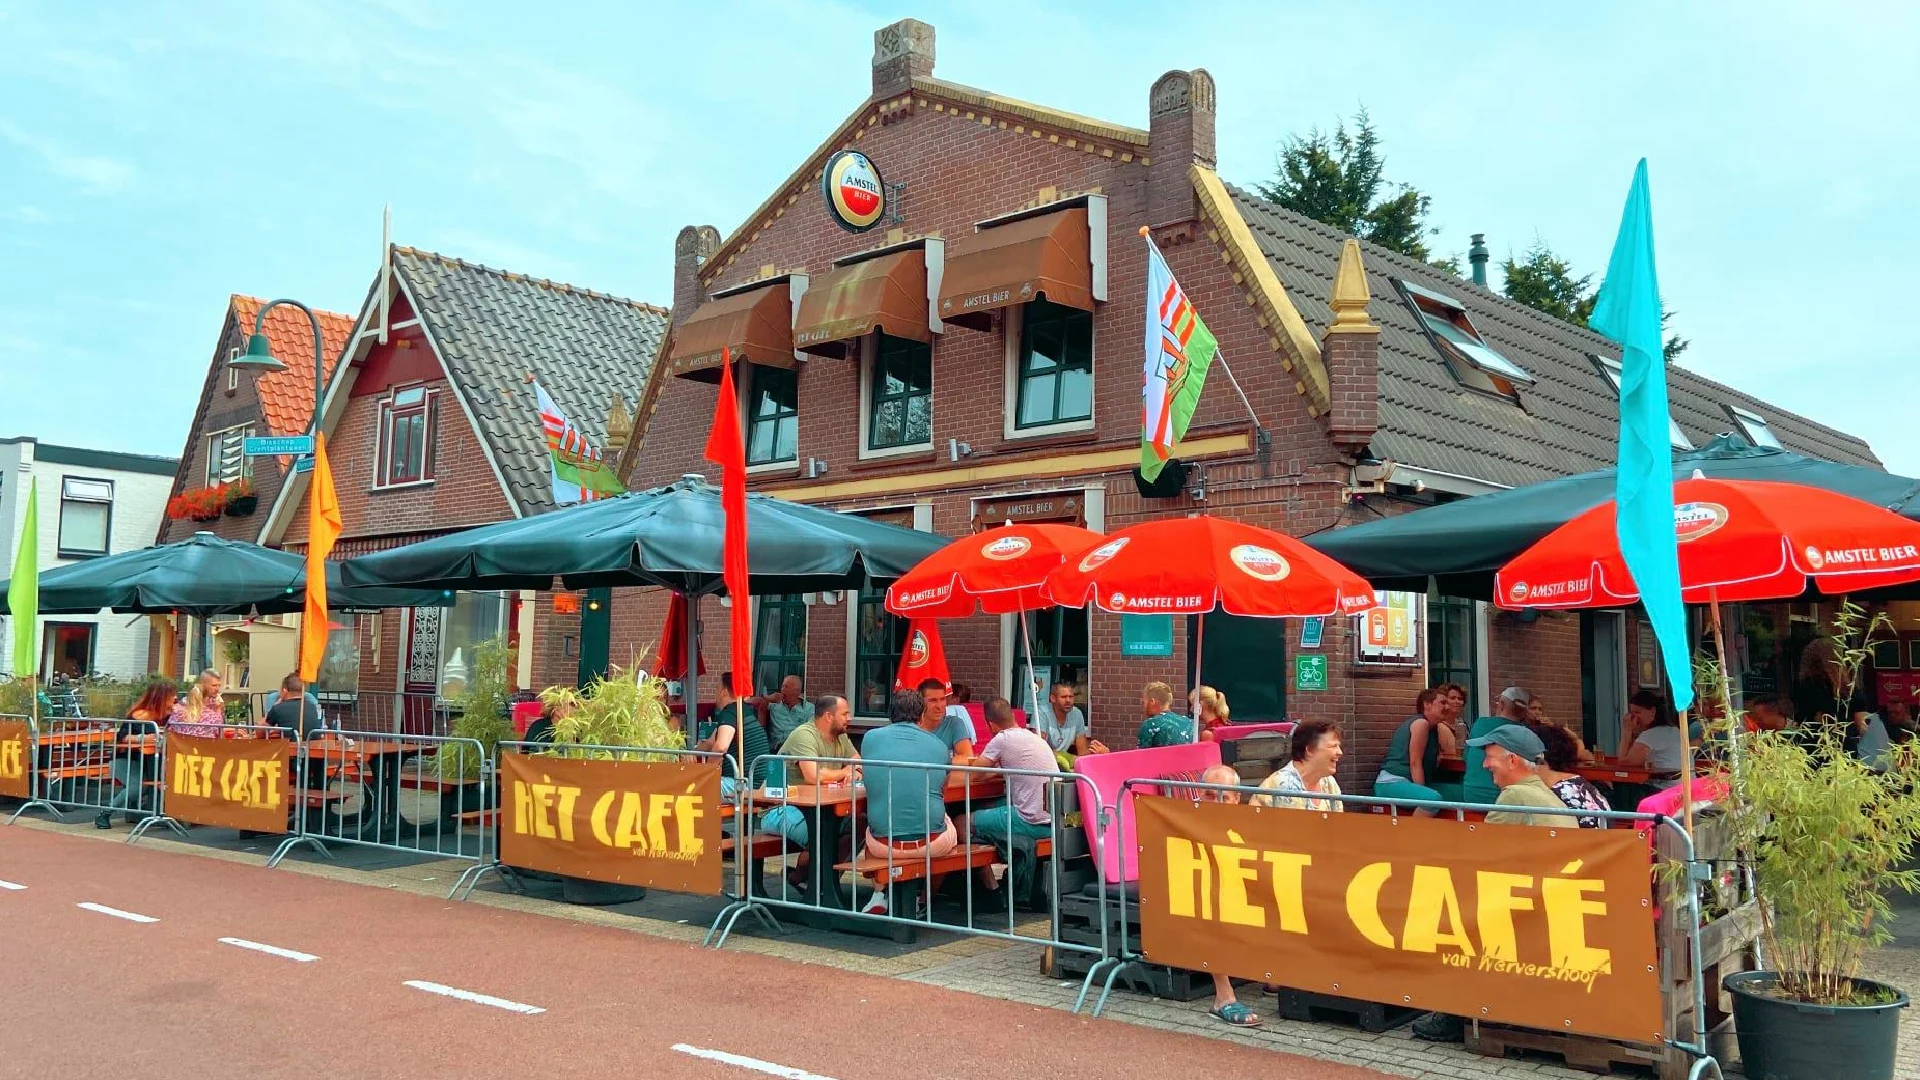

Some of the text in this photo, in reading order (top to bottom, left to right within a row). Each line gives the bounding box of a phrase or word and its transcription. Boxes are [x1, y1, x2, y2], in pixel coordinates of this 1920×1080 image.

[846, 175, 877, 193] AMSTEL
[854, 190, 872, 202] BIER
[963, 290, 1010, 308] AMSTEL BIER
[689, 352, 723, 367] AMSTEL BIE
[260, 438, 295, 446] Bisschop
[1006, 502, 1053, 516] AMSTEL BIER
[1673, 513, 1708, 522] MSTEL
[1825, 545, 1919, 564] AMSTEL BIER
[910, 589, 935, 603] AMSTEL
[1529, 578, 1589, 598] AMSTEL BIER
[1127, 596, 1202, 608] AMSTEL BIER
[0, 733, 22, 776] FÉ
[174, 747, 282, 806] HÈT CAFÉ
[514, 774, 704, 855] HÈT CAFÉ
[632, 847, 646, 857] van
[1166, 829, 1612, 974] HÈT CAFÉ
[1442, 945, 1610, 993] van Wervershoof
